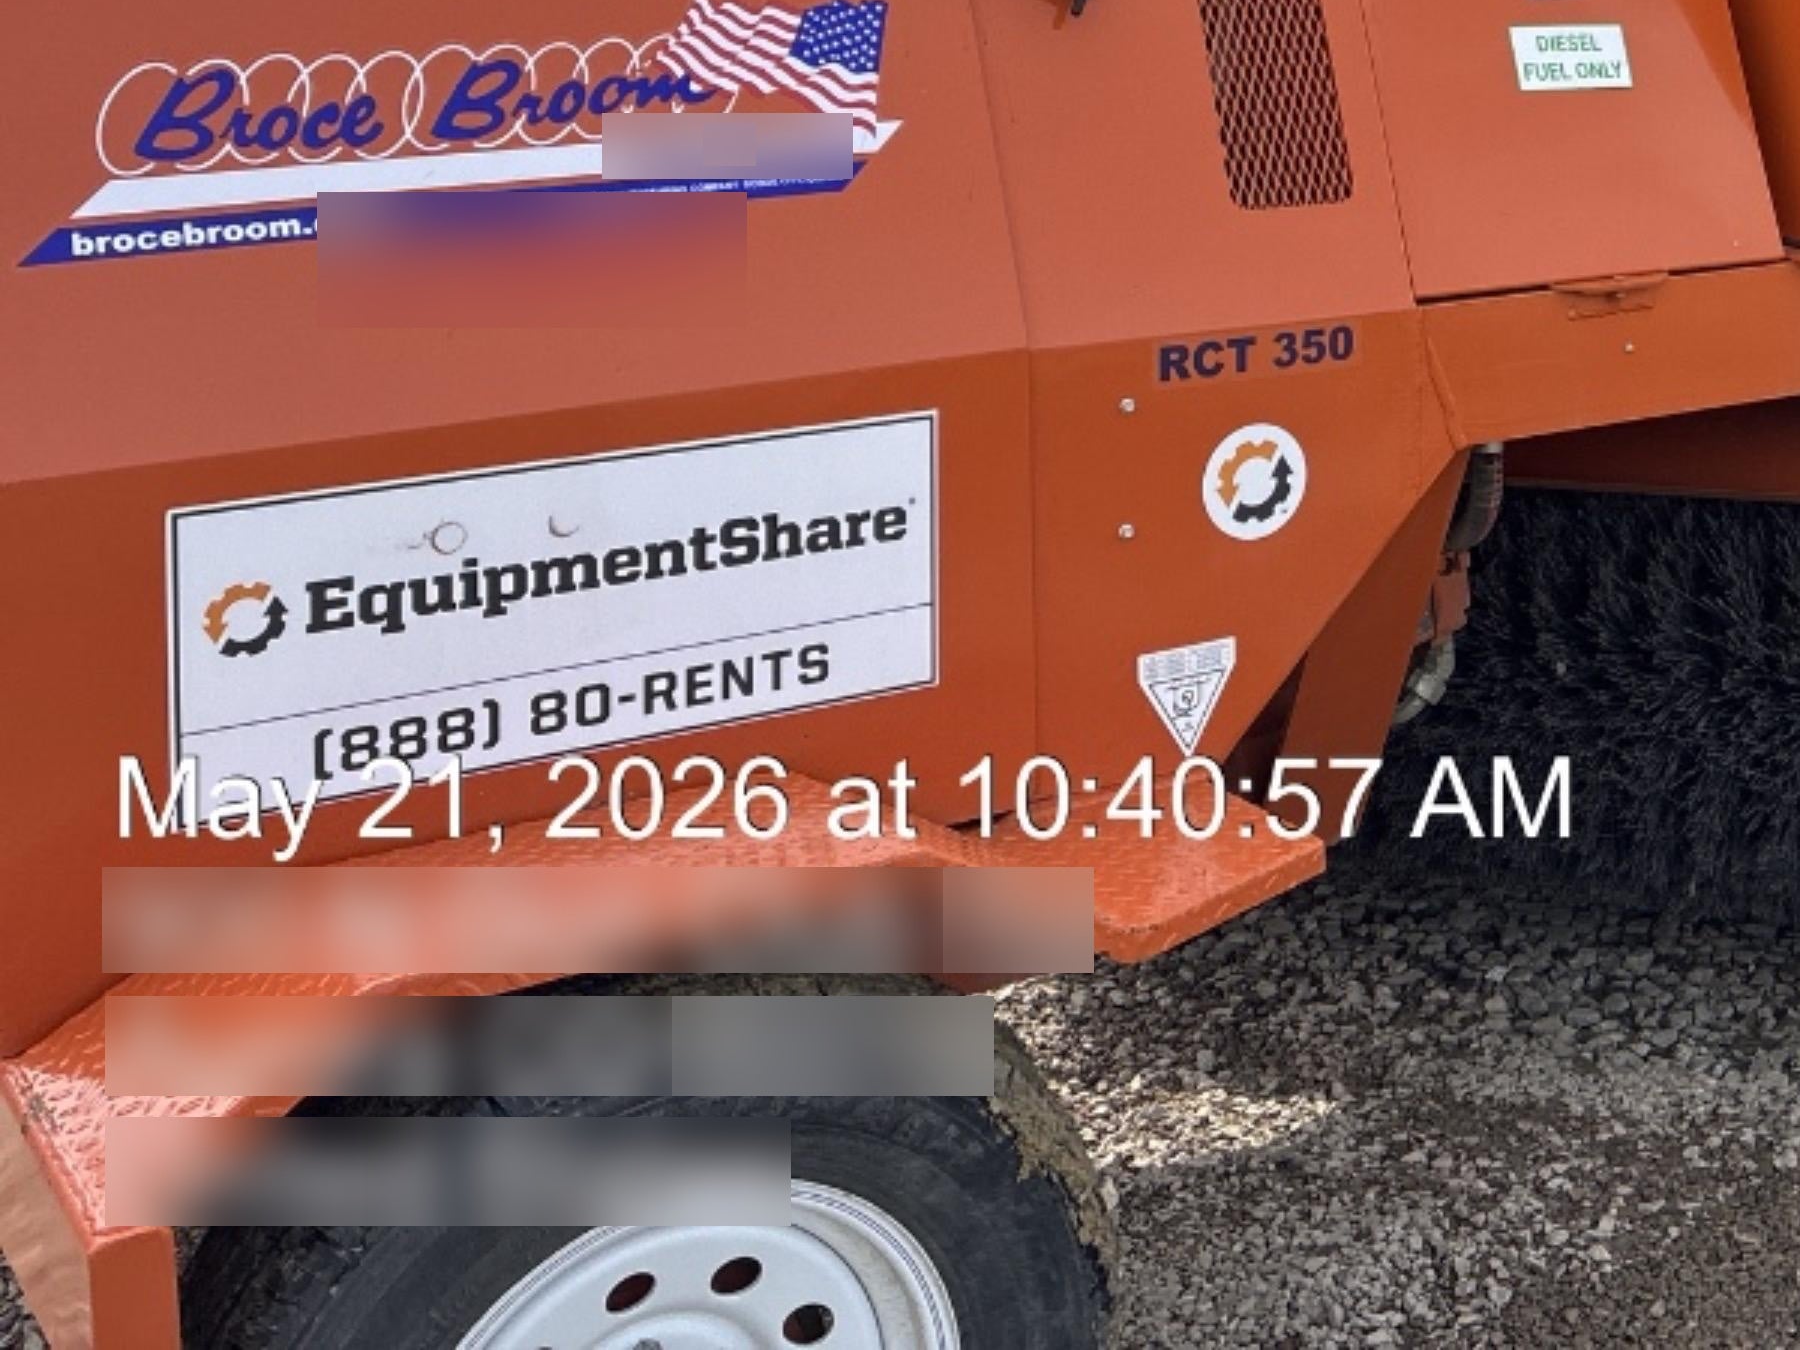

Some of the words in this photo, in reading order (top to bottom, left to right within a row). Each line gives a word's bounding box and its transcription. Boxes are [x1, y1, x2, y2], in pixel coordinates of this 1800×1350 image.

[1523, 61, 1571, 82] FUEL
[1575, 60, 1623, 80] ONLY
[1536, 33, 1602, 53] DIESEL
[134, 67, 385, 164] Broce
[433, 59, 717, 147] Broom
[1158, 334, 1257, 383] RCT
[1273, 325, 1356, 368] 350
[305, 503, 909, 636] EquipmentShare
[312, 698, 501, 782] (888)
[529, 642, 831, 736] 80-RENTS
